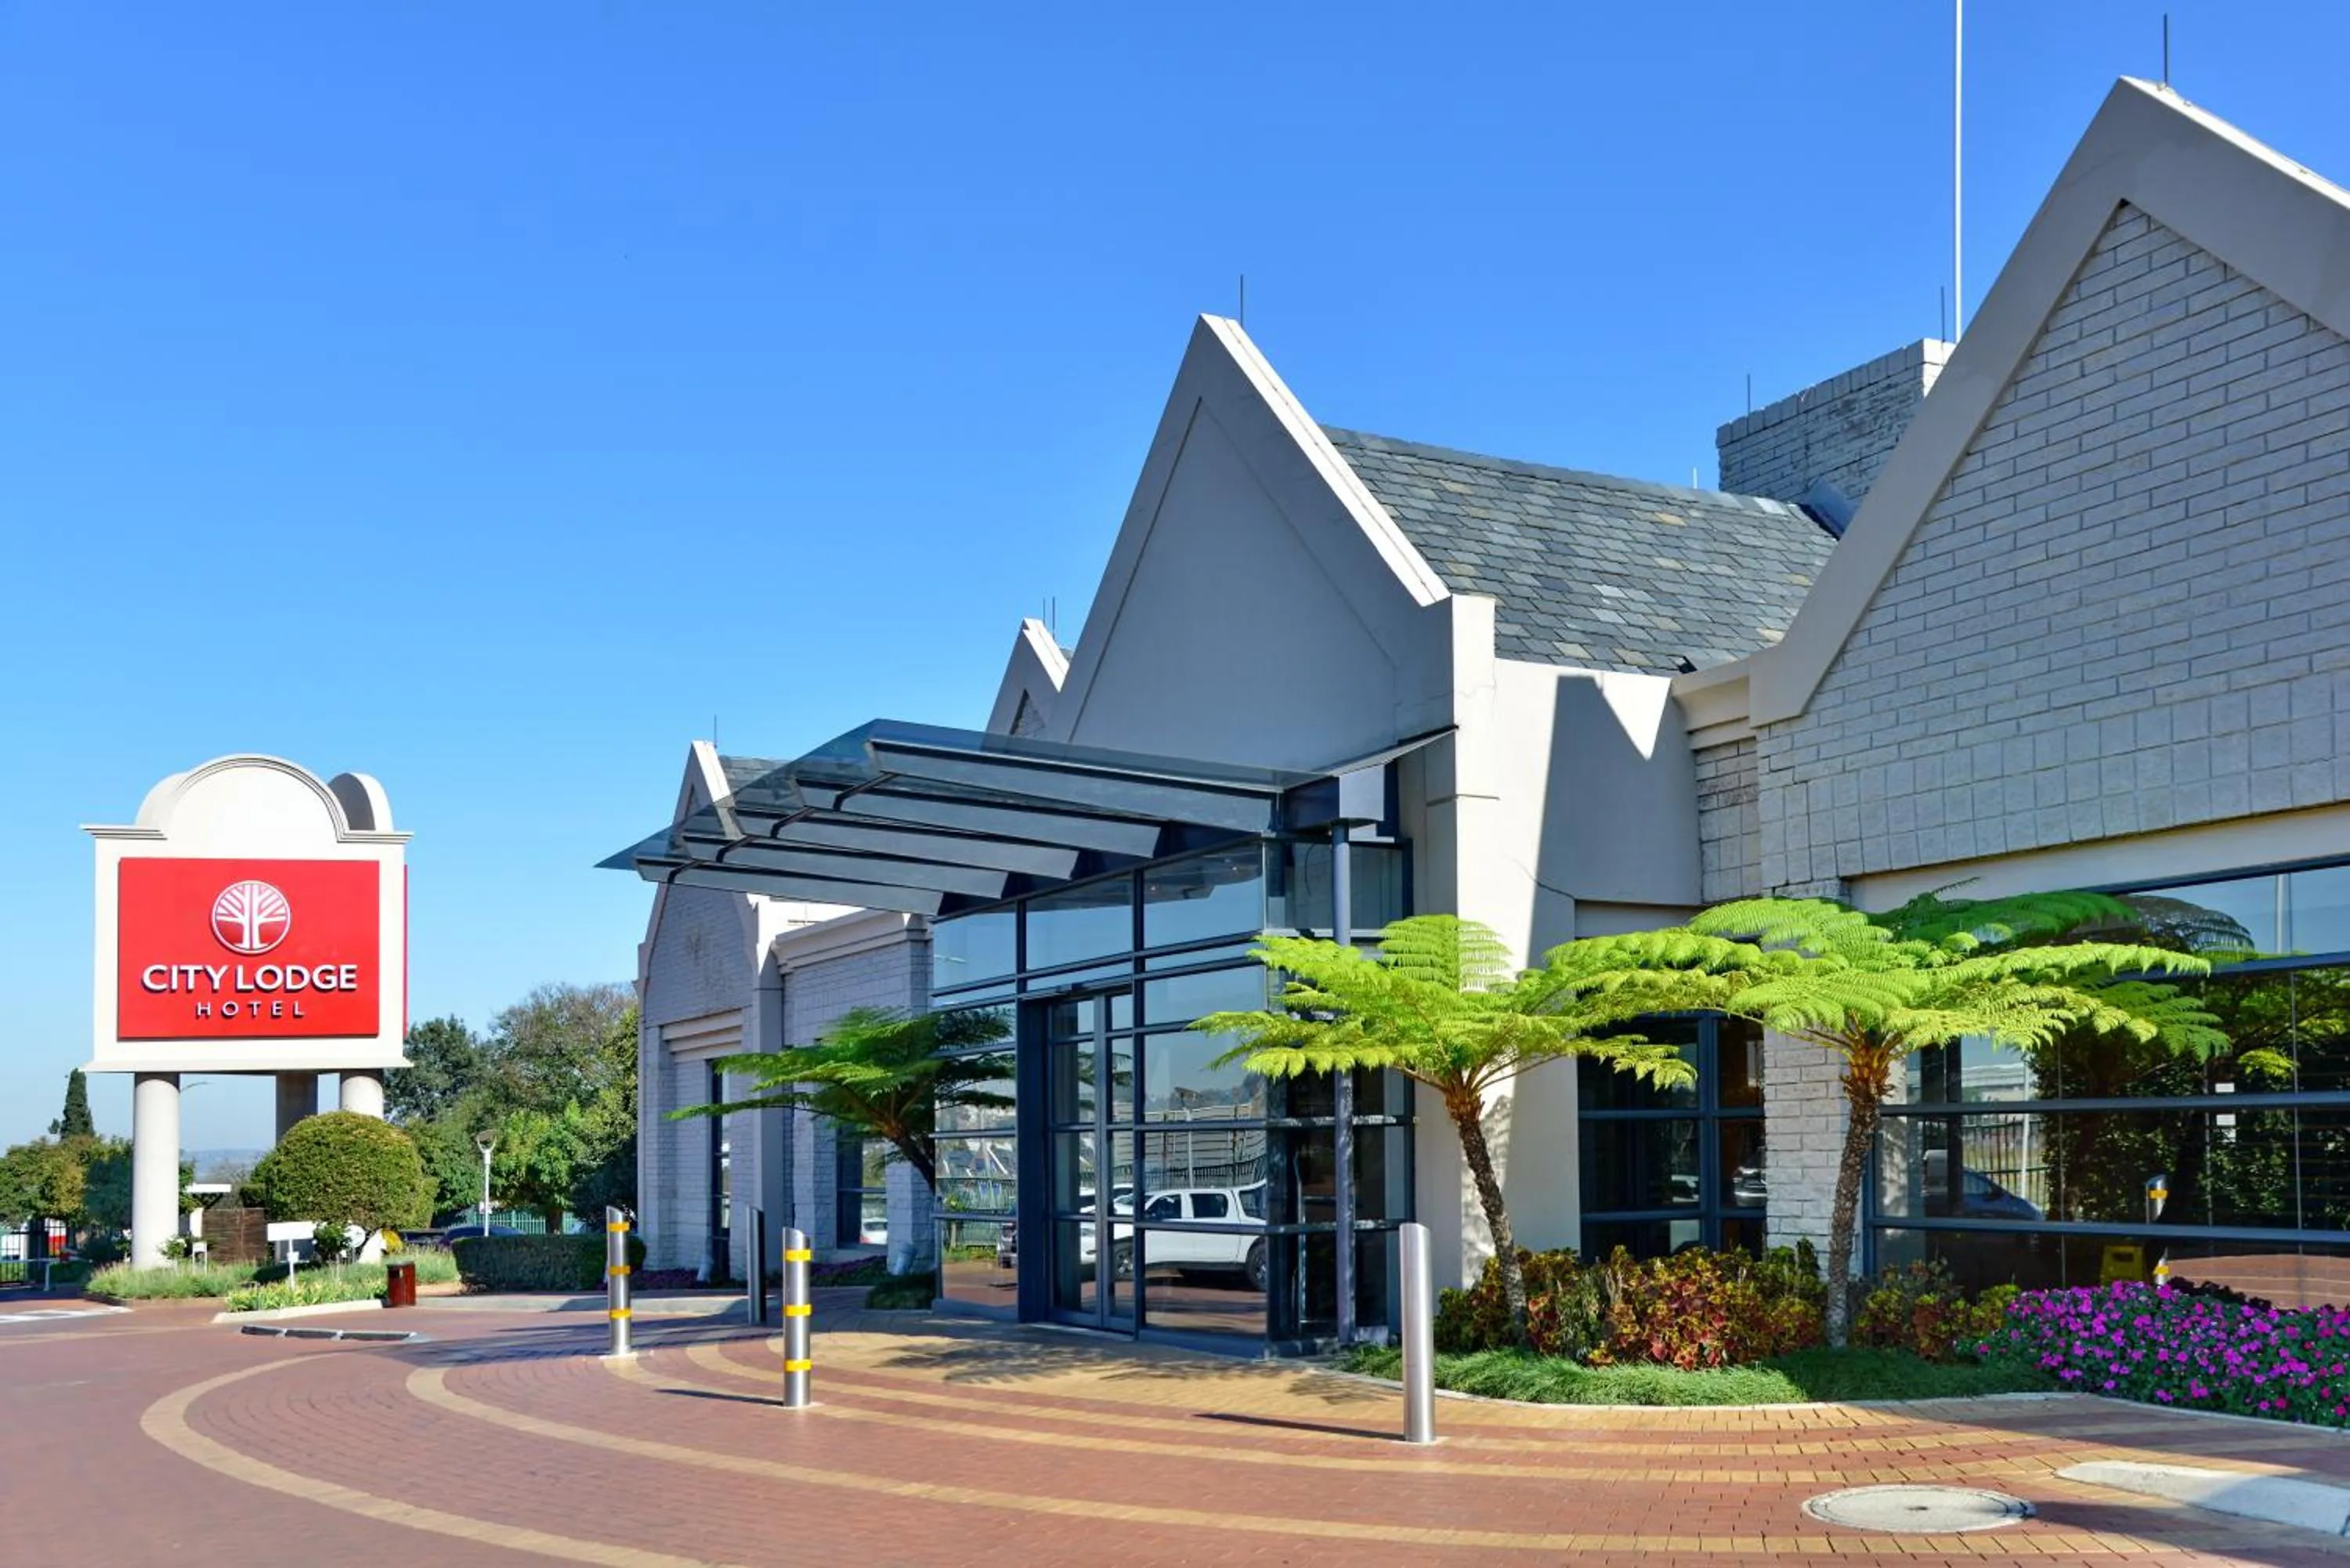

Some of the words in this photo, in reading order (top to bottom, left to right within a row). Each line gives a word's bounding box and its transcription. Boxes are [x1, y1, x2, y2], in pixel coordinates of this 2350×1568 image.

[142, 964, 229, 992] CITY
[236, 964, 358, 992] LODGE
[196, 1000, 305, 1017] HOTEL
